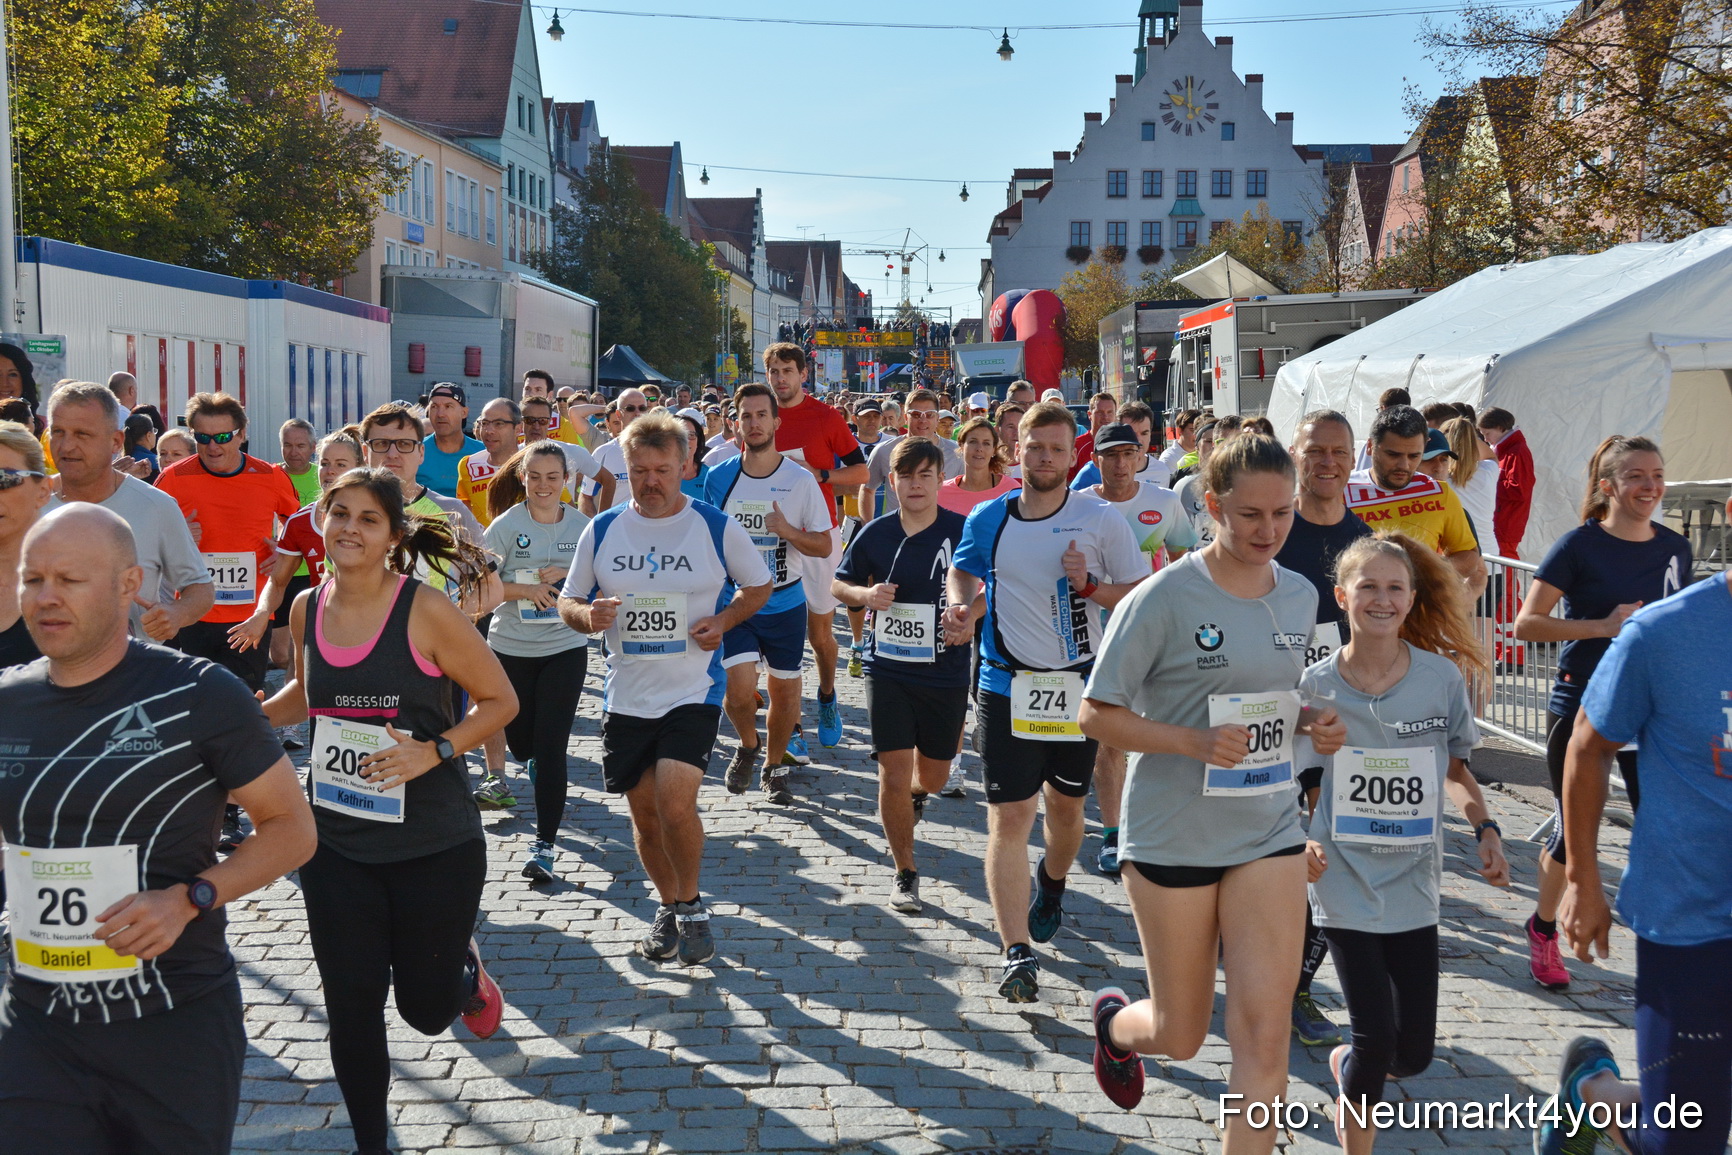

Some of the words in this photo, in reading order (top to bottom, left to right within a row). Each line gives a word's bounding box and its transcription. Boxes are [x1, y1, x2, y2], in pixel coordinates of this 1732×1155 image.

[472, 484, 487, 494] MA
[1398, 500, 1445, 517] BÖGL
[558, 543, 578, 551] BOC
[612, 547, 693, 579] SUSPA
[220, 592, 234, 600] Jan
[635, 598, 666, 606] BOCK
[625, 611, 677, 632] 2395
[1060, 593, 1077, 657] TECHNOLGY
[1067, 577, 1093, 658] UBER
[884, 616, 925, 639] 2385
[639, 643, 665, 653] Albert
[895, 646, 911, 656] Tom
[1197, 655, 1228, 665] PARTL
[1197, 662, 1229, 670] Neumarkt
[1033, 676, 1065, 685] BOCK
[335, 695, 400, 707] OBSESSION
[1028, 690, 1067, 711] 274
[1242, 701, 1278, 715] BOCK
[1029, 723, 1065, 733] Dominic
[1397, 717, 1447, 735] BOCK
[341, 729, 379, 746] BOCK
[1247, 718, 1284, 754] 066
[105, 738, 163, 753] Reebok
[1364, 757, 1409, 768] BOCK
[332, 776, 349, 786] PARTL
[350, 781, 375, 792] Neumarkt
[1243, 772, 1270, 785] Anna
[1349, 774, 1424, 805] 2068
[338, 789, 374, 810] Kathrin
[1355, 806, 1377, 815] PARTL
[1378, 808, 1410, 816] Neumarkt
[1370, 820, 1403, 835] Carla
[32, 860, 93, 876] BOCK
[38, 887, 88, 926] 26
[30, 930, 51, 940] PARTL
[41, 949, 91, 967] Daniel
